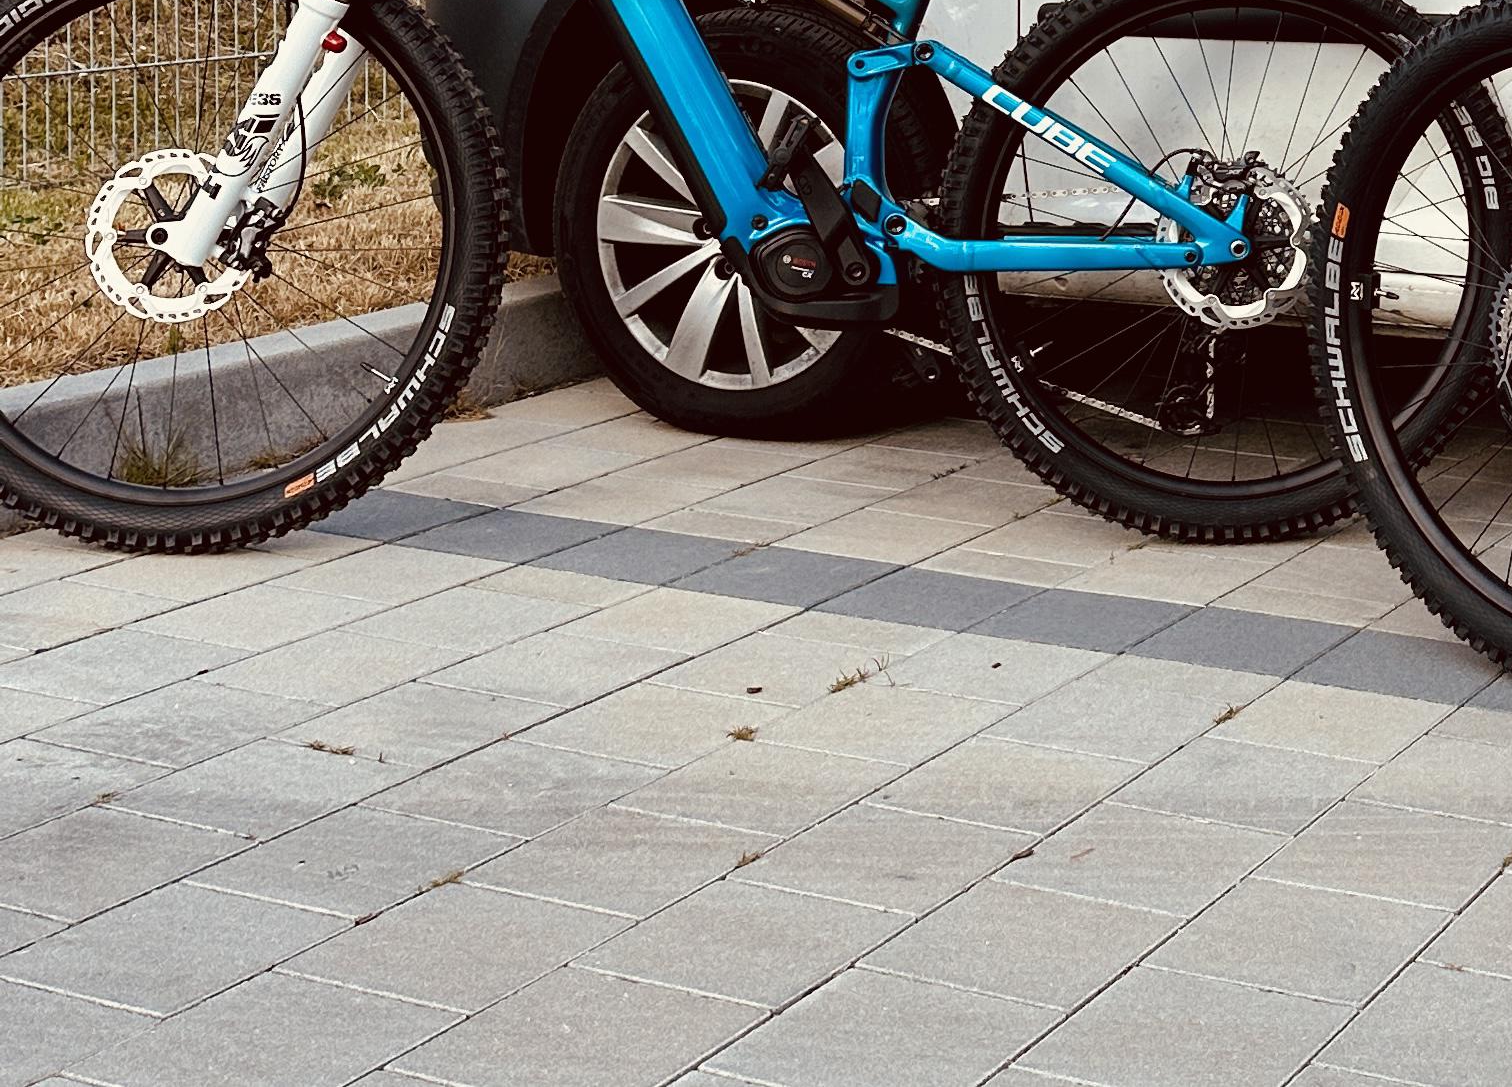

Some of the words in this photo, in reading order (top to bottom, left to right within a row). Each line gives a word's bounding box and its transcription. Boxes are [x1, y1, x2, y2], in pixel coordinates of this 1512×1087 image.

[981, 84, 1117, 174] CUBE
[1475, 155, 1500, 210] BIG
[315, 302, 456, 484] SCHWALBE
[963, 274, 1065, 454] SCHWALBE
[1324, 236, 1369, 463] SCHWALBE
